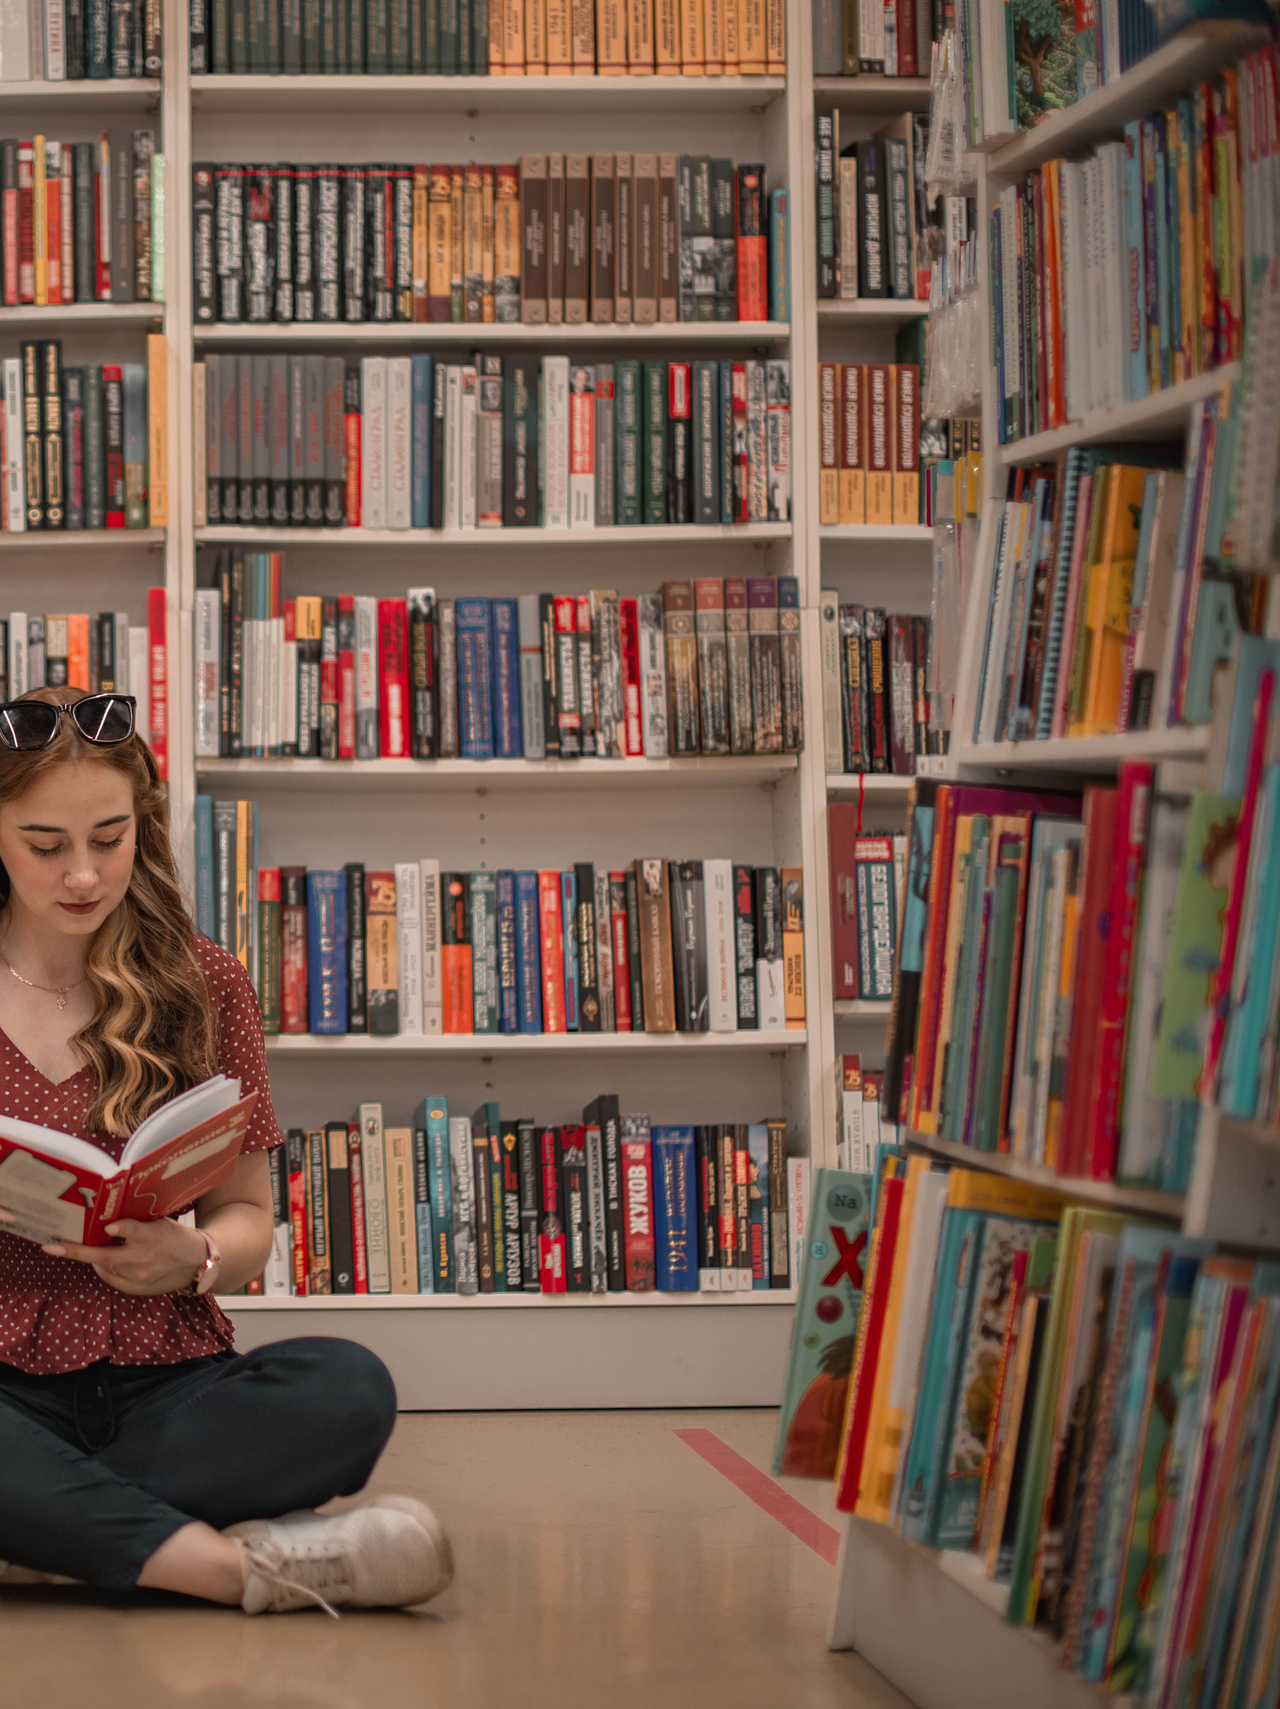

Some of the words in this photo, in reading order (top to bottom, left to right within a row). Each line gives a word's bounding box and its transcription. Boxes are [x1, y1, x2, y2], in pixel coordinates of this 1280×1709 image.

[871, 864, 894, 996] БЕЛОГВАРДЕЙЩИНА
[606, 1118, 617, 1160] ГОЛОДА
[608, 1160, 618, 1200] ТИСКАХ
[626, 1164, 649, 1235] ЖУКОВ
[460, 1201, 471, 1223] КГБ
[505, 1193, 518, 1229] АРТУР
[609, 1202, 618, 1210] В
[834, 1194, 857, 1210] Na
[505, 1231, 519, 1286] АРТУЗОВ
[667, 1228, 687, 1274] 1941
